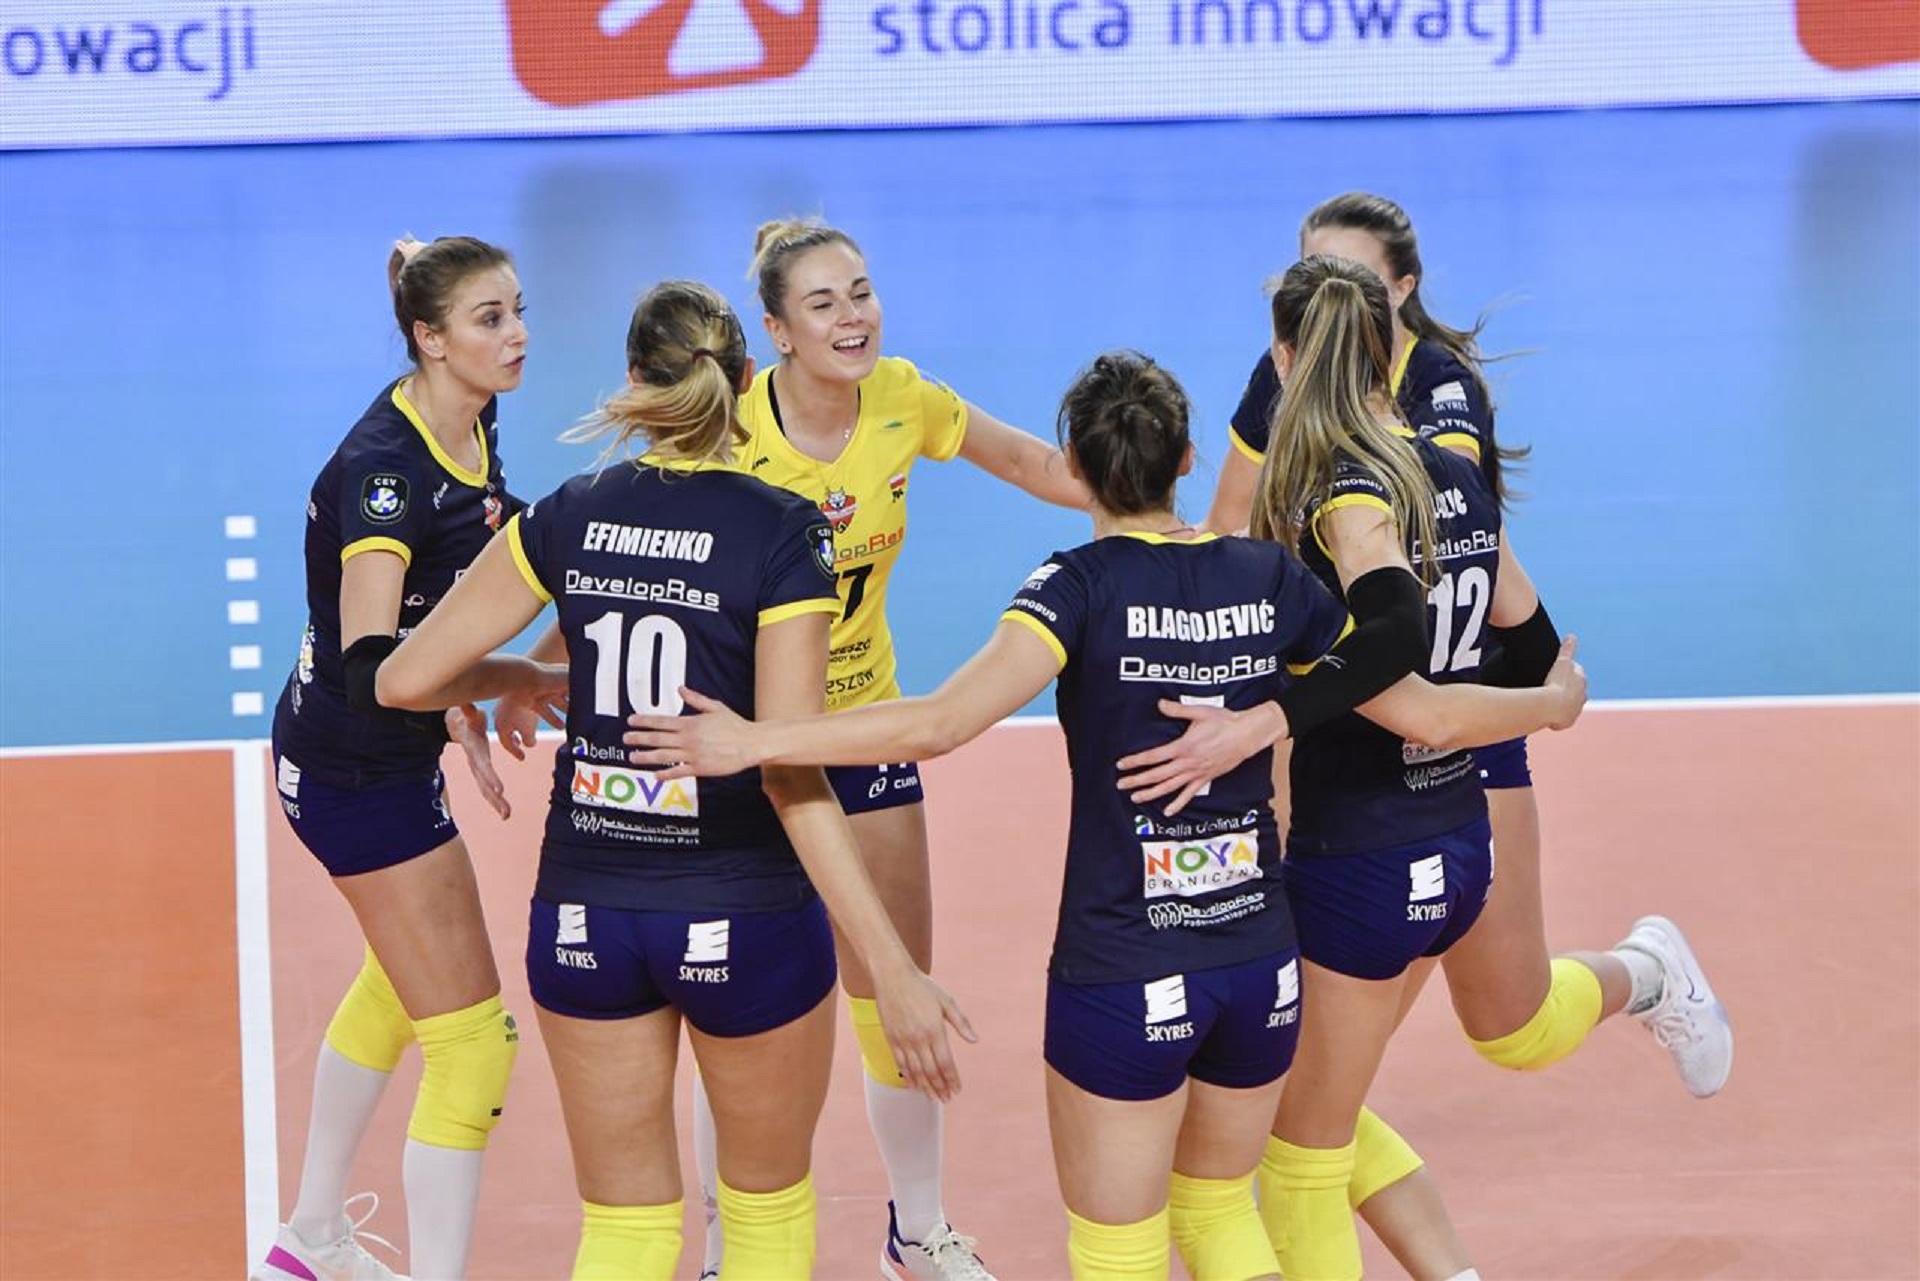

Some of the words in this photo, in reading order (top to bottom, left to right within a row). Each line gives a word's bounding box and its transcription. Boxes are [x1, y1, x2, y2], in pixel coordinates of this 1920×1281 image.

[873, 0, 1129, 54] stolica
[4, 8, 255, 101] owacji
[374, 477, 397, 486] CEV
[583, 521, 714, 563] EFIMIENKO
[566, 570, 720, 612] DevelopRes
[1127, 599, 1276, 643] BLAGOJEVIĆ
[1427, 566, 1490, 675] 12
[584, 612, 687, 717] 10
[1120, 655, 1277, 685] DevelopRes
[590, 743, 625, 761] bella
[573, 767, 694, 811] NOVA
[1147, 839, 1254, 876] NOVA
[1406, 902, 1448, 921] SKYRES
[555, 946, 598, 970] SKYRES
[678, 965, 730, 983] SKYRES
[1145, 1021, 1194, 1042] SKYRES
